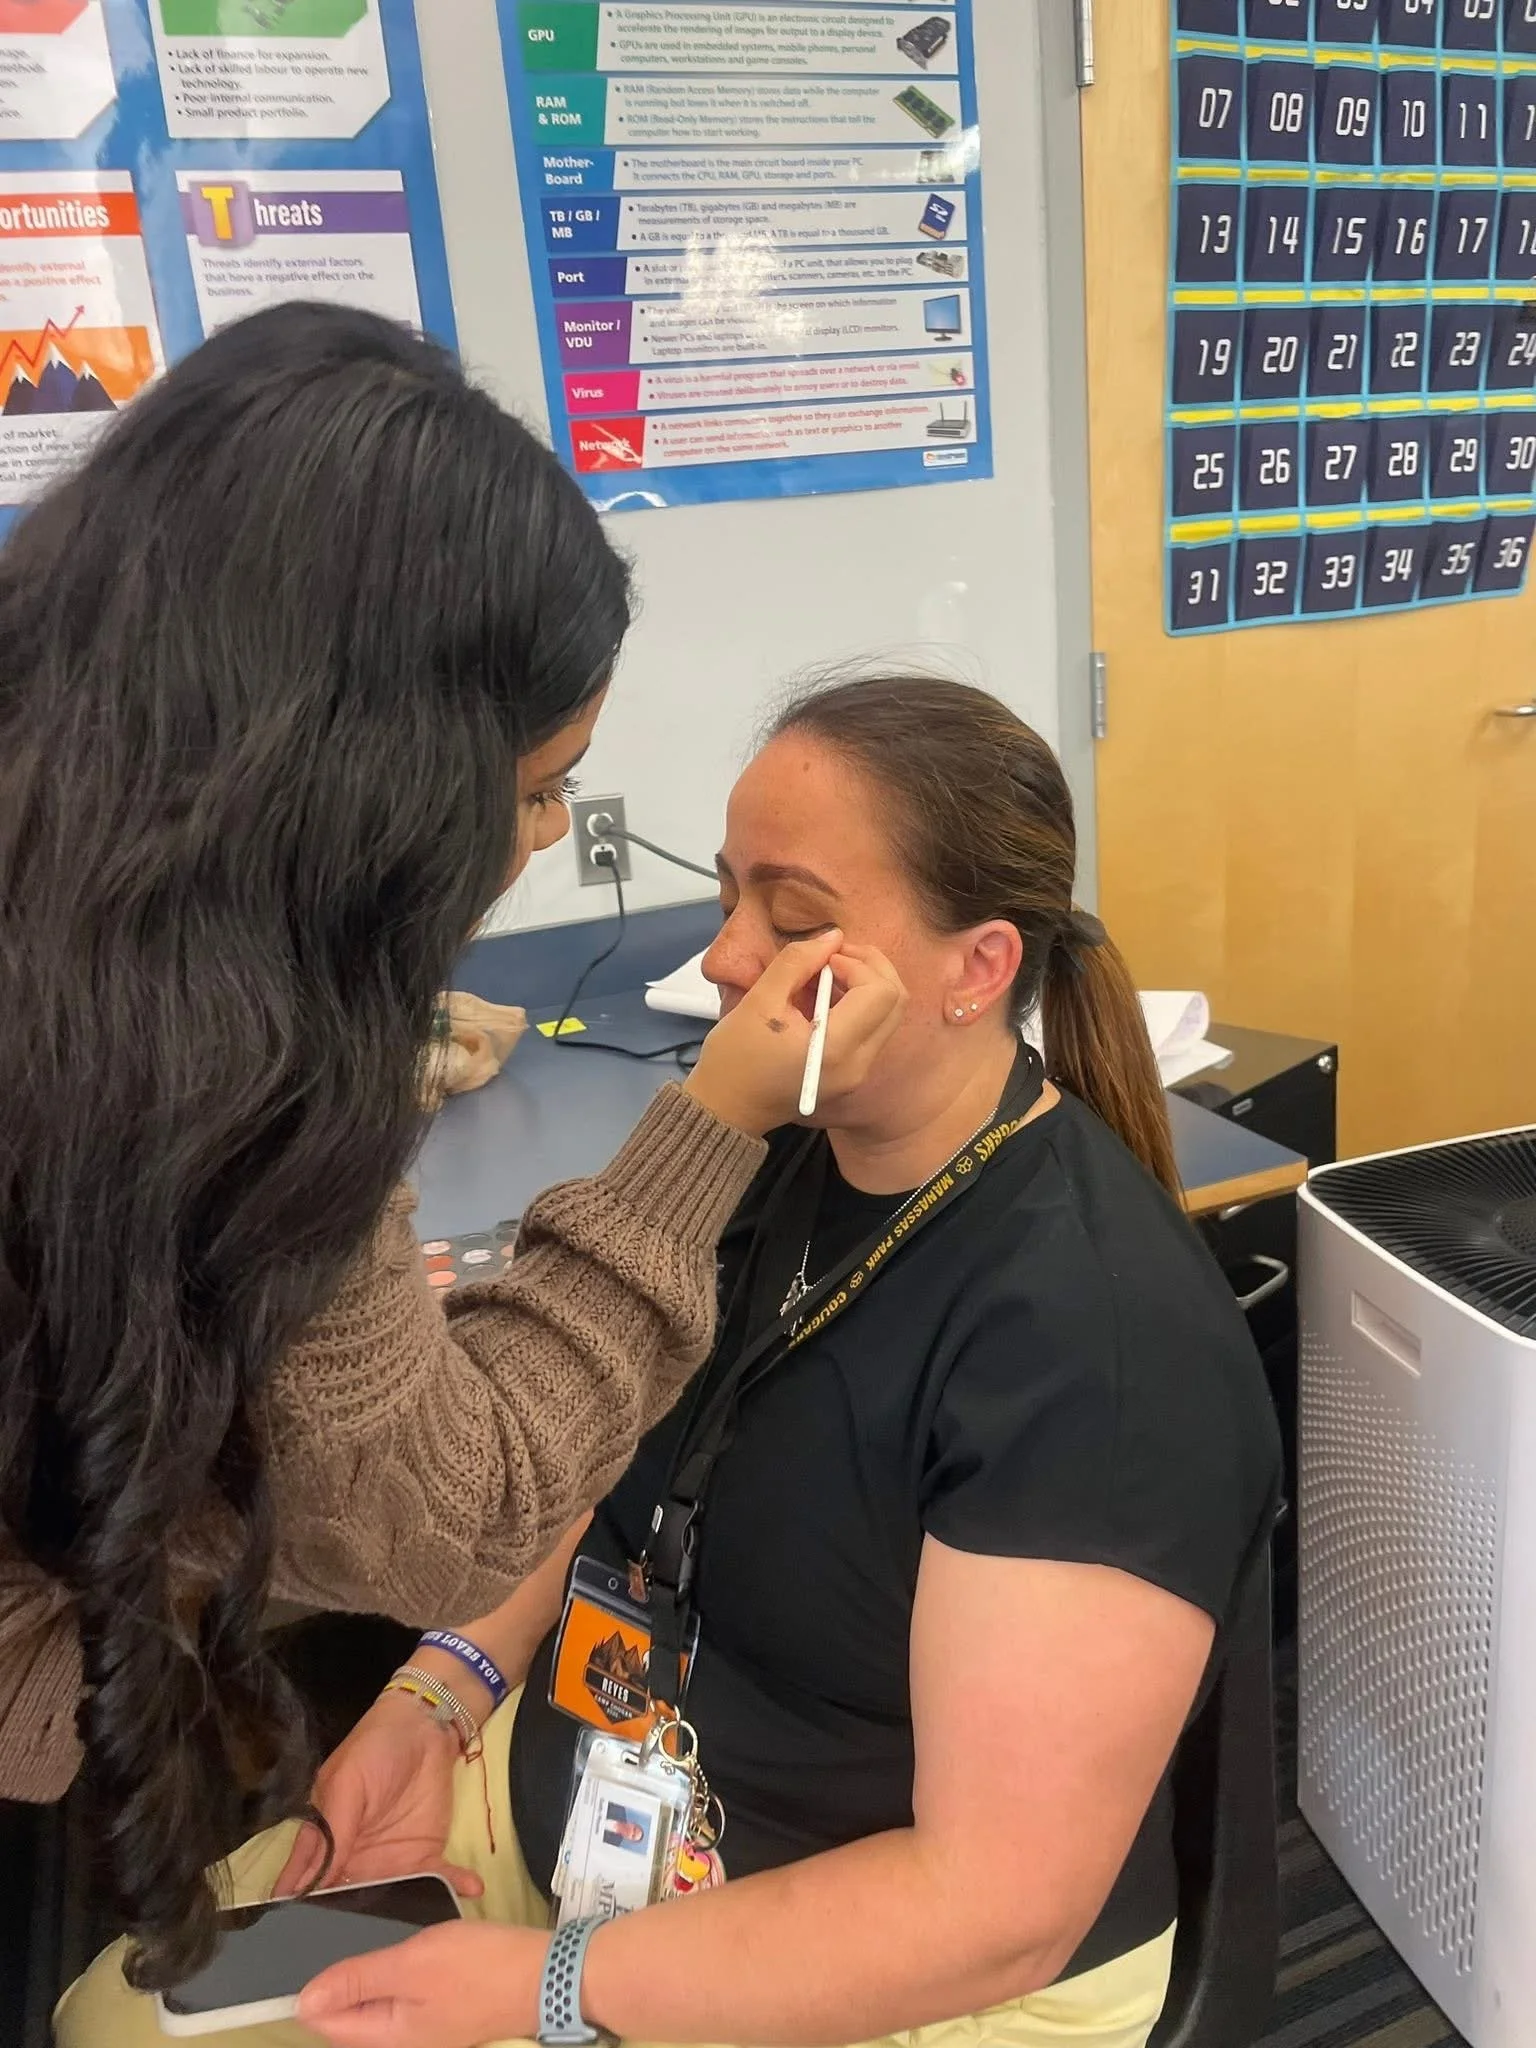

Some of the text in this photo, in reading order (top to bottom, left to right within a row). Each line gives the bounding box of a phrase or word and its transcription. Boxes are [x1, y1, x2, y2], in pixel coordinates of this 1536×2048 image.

[527, 28, 556, 42] GPU
[175, 49, 200, 60] Lack
[202, 48, 214, 59] of
[216, 49, 255, 61] finance
[257, 50, 272, 61] for
[178, 63, 201, 74] Lack
[204, 63, 216, 74] of
[218, 63, 253, 75] skilled
[290, 65, 302, 75] to
[346, 67, 368, 76] new
[183, 94, 207, 104] Poor
[210, 94, 250, 104] internal
[535, 95, 567, 109] RAM
[185, 108, 214, 118] Small
[217, 108, 258, 120] product
[538, 113, 582, 126] & ROM
[1199, 87, 1536, 141] 07 08 09 10 11 1
[542, 156, 595, 169] Mother-
[632, 159, 648, 168] The
[650, 158, 706, 168] motherboard
[716, 158, 731, 167] the
[781, 157, 805, 167] board
[544, 172, 583, 185] Board
[682, 172, 696, 181] the
[796, 170, 811, 180] and
[637, 203, 677, 214] Terabytes
[700, 202, 740, 214] gigabytes
[761, 201, 777, 211] and
[778, 200, 822, 213] megabytes
[549, 210, 565, 222] TB
[575, 210, 593, 222] GB
[702, 215, 711, 225] of
[551, 227, 573, 238] MB
[1200, 214, 1536, 255] 13 14 15 16 17 1
[203, 258, 241, 269] Threats
[243, 258, 281, 270] identify
[284, 257, 326, 268] external
[205, 272, 227, 283] that
[229, 272, 254, 283] have
[265, 272, 309, 284] negative
[311, 271, 341, 282] effect
[343, 273, 356, 281] on
[358, 271, 375, 281] the
[557, 271, 585, 284] Port
[563, 320, 615, 333] Monitor
[566, 336, 593, 349] VDU
[1198, 331, 1536, 376] 19 20 21 22 23 24
[571, 386, 605, 399] Virus
[1192, 436, 1536, 490] 25 26 27 28 29 30
[1187, 536, 1526, 605] 31 32 33 34 35 36
[893, 1172, 955, 1238] MANASSAS
[865, 1236, 894, 1271] PARK
[441, 1634, 500, 1685] LOVES YOU
[601, 1677, 629, 1703] REYES
